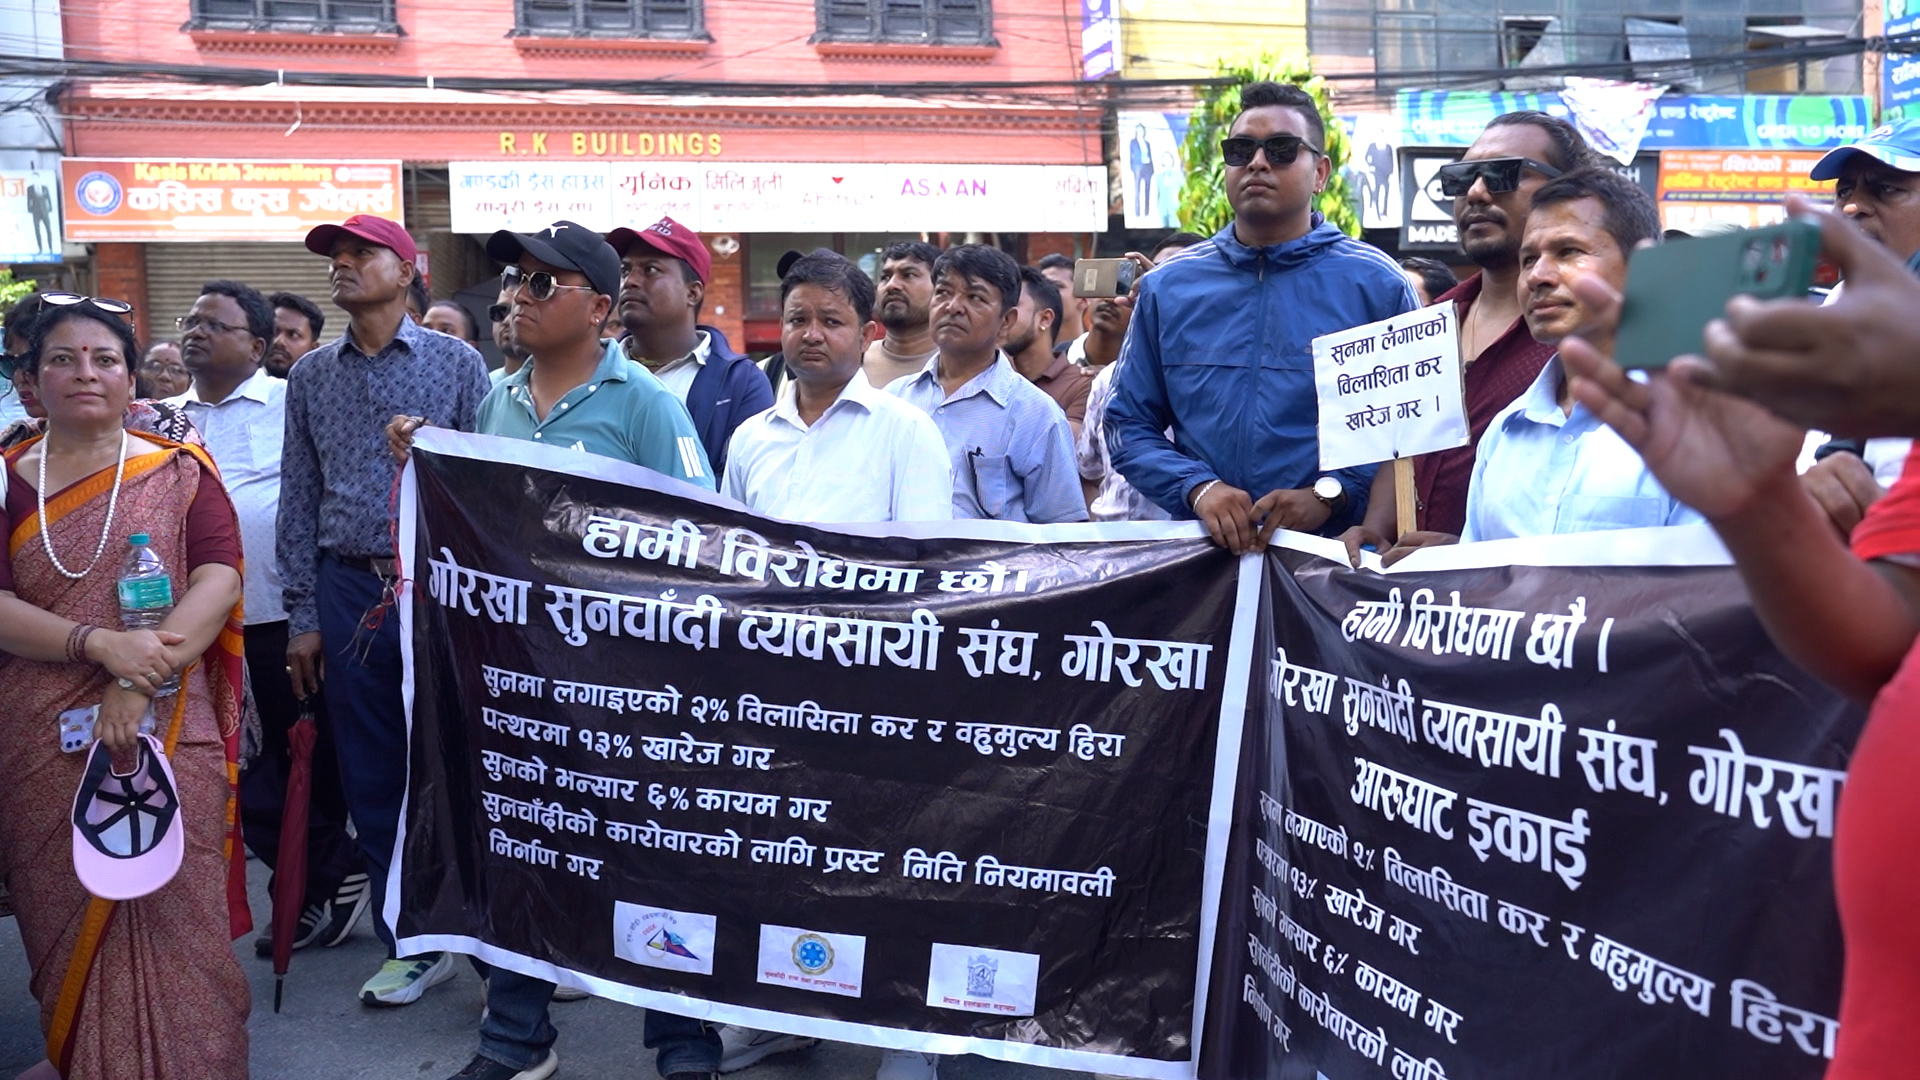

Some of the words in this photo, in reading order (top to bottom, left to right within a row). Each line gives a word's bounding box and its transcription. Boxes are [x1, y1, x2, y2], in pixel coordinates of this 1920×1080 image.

[500, 132, 548, 156] R.K
[572, 132, 723, 156] BUILDINGS
[1757, 125, 1797, 139] OPEN
[1801, 125, 1820, 138] TO
[1824, 125, 1866, 139] MORE
[134, 162, 188, 181] Kasis
[189, 163, 241, 181] Krish
[243, 163, 333, 182] Jewellers
[1408, 225, 1458, 243] MADE
[1330, 335, 1375, 366] सुनमा
[1337, 364, 1410, 397] विलाशिता
[1415, 355, 1443, 379] कर
[1345, 404, 1391, 431] खारेज
[1396, 399, 1422, 420] गर
[583, 515, 706, 570] हामी
[720, 528, 925, 593] विरोधमा
[428, 547, 533, 625] गोरखा
[545, 584, 727, 651] सुनचाँदी
[738, 607, 943, 671] व्यवसायी
[957, 618, 1041, 681] संघ,
[1060, 620, 1213, 691] गोरखा
[1342, 587, 1405, 643] हामी
[1400, 588, 1525, 661] विरोधमा
[482, 664, 545, 698] सुनमा
[552, 679, 683, 716] लगाइएको
[690, 695, 730, 724] २%
[737, 693, 862, 735] विलासिता
[870, 714, 919, 740] कर
[927, 719, 947, 743] र
[955, 720, 1061, 758] वहुमुल्य
[1068, 722, 1126, 760] हिरा
[482, 706, 570, 747] पत्थरमा
[578, 727, 633, 759] १३%
[641, 731, 724, 766] खारेज
[731, 745, 775, 771] गर
[482, 749, 548, 785] सुनको
[554, 767, 639, 802] भन्सार
[647, 783, 690, 812] ६%
[695, 787, 781, 817] कायम
[788, 796, 832, 823] गर
[1342, 674, 1418, 744] सुनचाँदी
[1422, 698, 1567, 779] व्यवसायी
[1576, 719, 1668, 806] संघ,
[1687, 727, 1849, 839] गोरख
[482, 790, 599, 837] सुनचाँदीको
[604, 819, 743, 859] कारोवारको
[750, 835, 817, 867] लागि
[822, 846, 885, 874] प्रस्ट
[903, 847, 967, 883] निति
[974, 855, 1116, 898] नियमावली
[489, 827, 560, 870] निर्माण
[565, 852, 604, 881] गर
[1466, 797, 1592, 892] इकाई
[1285, 808, 1348, 860] लगाएको
[1353, 841, 1375, 871] २%
[1384, 846, 1489, 923] विलासिता
[1497, 899, 1550, 948] कर
[1561, 920, 1585, 960] र
[1589, 933, 1715, 1018] बहुमुल्य
[1729, 978, 1841, 1060] हिरा
[1290, 866, 1318, 899] १३%
[1324, 883, 1385, 935] खारेज
[1389, 914, 1423, 955] गर
[1279, 910, 1321, 963] भन्सार
[1323, 944, 1349, 974] ६%
[1355, 960, 1422, 1020] कायम
[1424, 998, 1464, 1045] गर
[1273, 1015, 1292, 1053] गर
[1298, 982, 1388, 1067] कारोवारको
